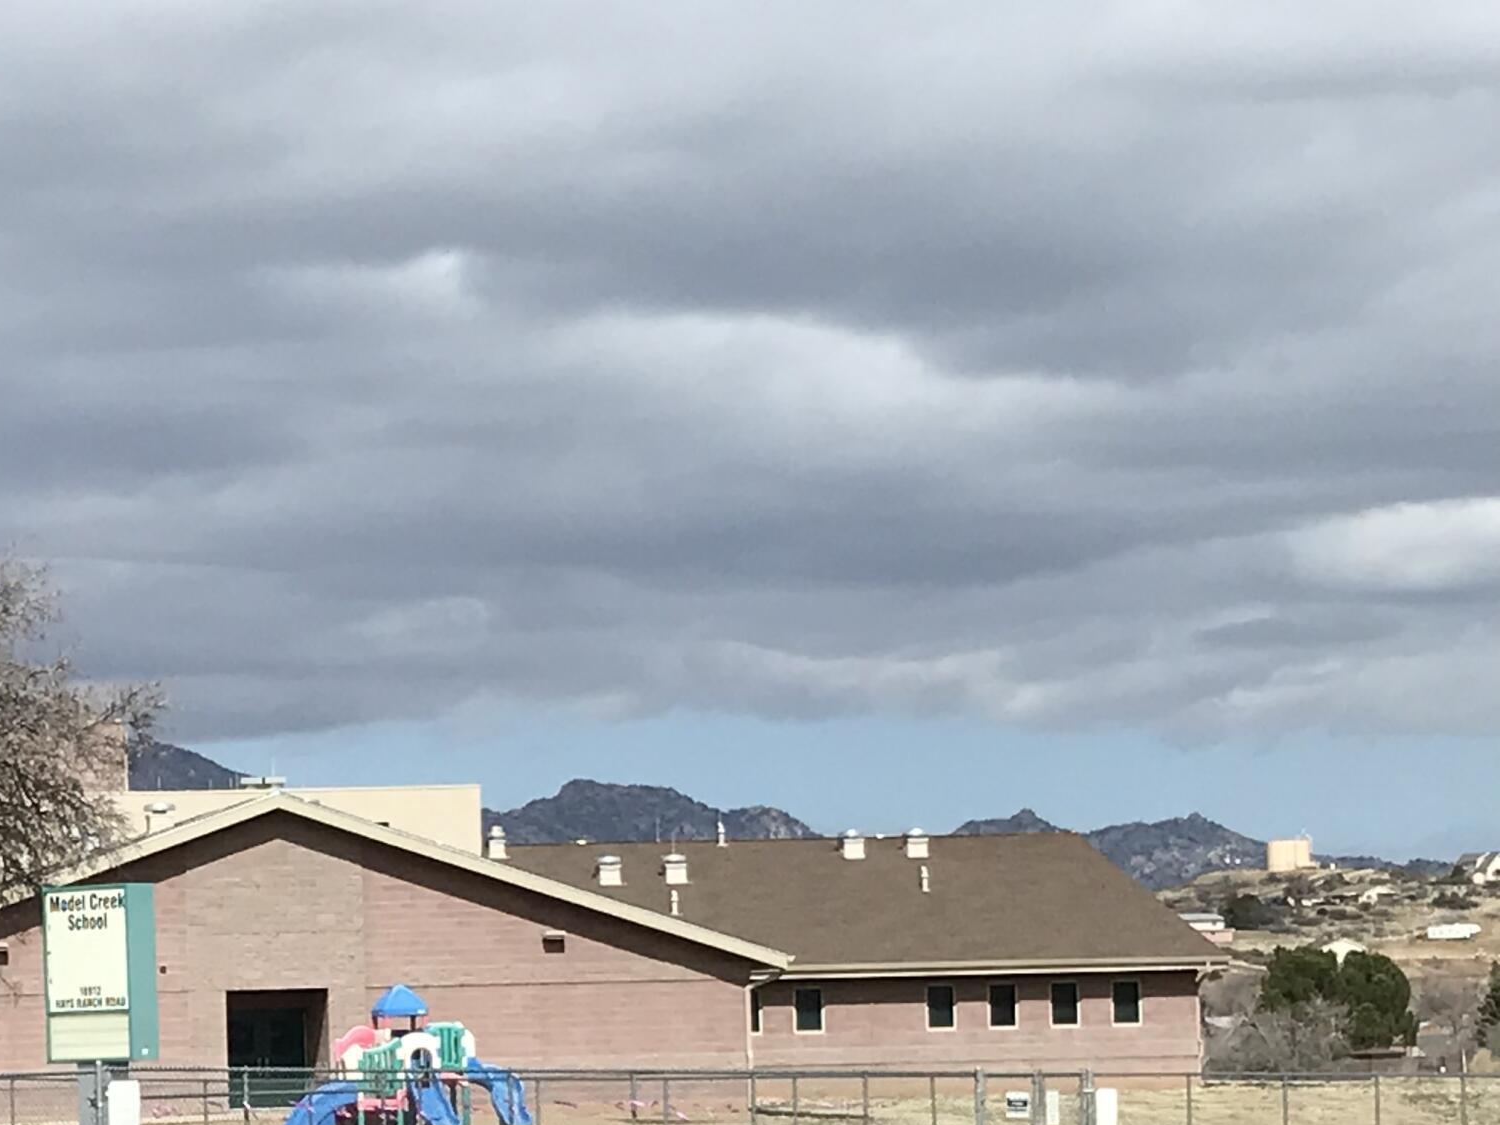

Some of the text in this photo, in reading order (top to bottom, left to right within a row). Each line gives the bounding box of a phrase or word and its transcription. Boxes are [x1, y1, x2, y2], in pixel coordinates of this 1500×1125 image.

[50, 893, 123, 912] Model Creek
[68, 912, 107, 931] School
[77, 998, 102, 1008] RANCH
[105, 997, 126, 1007] ROAD
